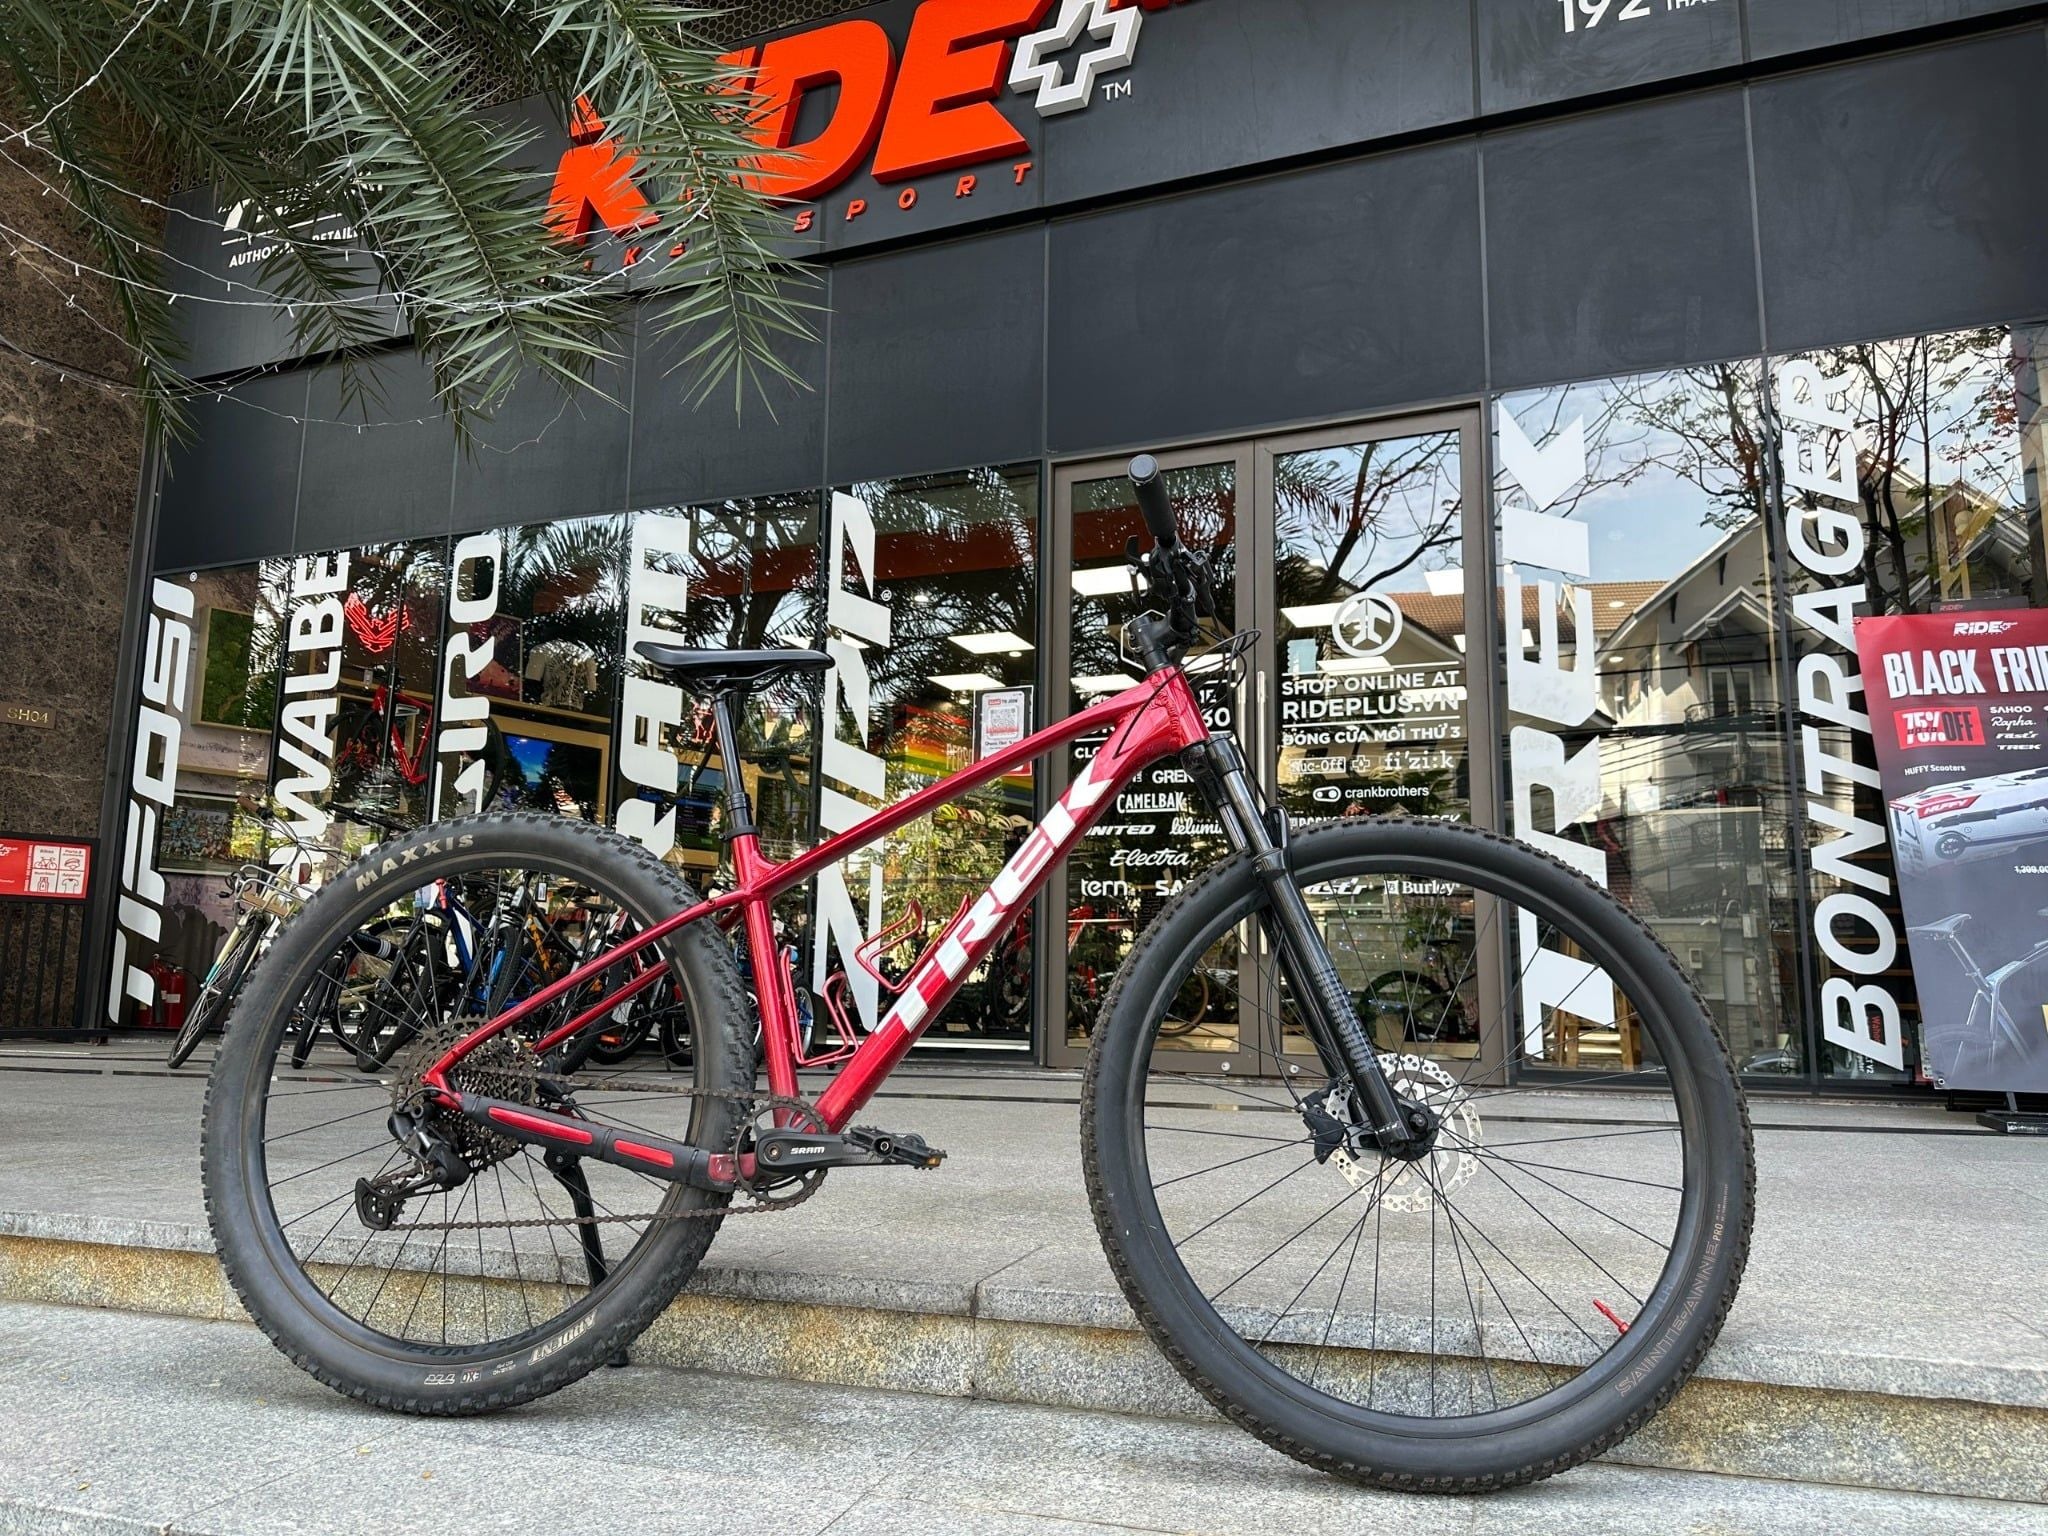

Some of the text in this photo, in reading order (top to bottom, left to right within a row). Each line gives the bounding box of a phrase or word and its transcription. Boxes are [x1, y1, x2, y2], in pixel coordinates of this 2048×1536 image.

[793, 162, 1033, 233] SPORT
[1281, 671, 1460, 695] SHOP ONLINE AT
[1882, 649, 1986, 699] BLACK
[616, 515, 690, 860] RAM
[1282, 693, 1459, 720] RIDEPLUS.VN
[1779, 358, 1904, 1071] BONTRAGER
[1990, 706, 2032, 714] SAHOO
[1410, 723, 1449, 740] THỨ
[1450, 726, 1461, 739] 3
[1498, 401, 1616, 1060] TREK
[1942, 711, 1973, 742] OFF
[1904, 764, 1966, 776] HUFFY Scooters
[107, 578, 195, 1024] TIFOSI
[1117, 792, 1184, 814] CAMELBAK
[1345, 786, 1430, 798] crankbrothers
[1924, 799, 1967, 816] HUFFY
[1085, 824, 1156, 836] NITED
[356, 834, 474, 892] MAXXIS
[1109, 848, 1190, 867] Electra
[875, 751, 1115, 1035] TREK
[1081, 878, 1128, 896] tern
[1402, 880, 1456, 896] Burley
[790, 1146, 826, 1155] SRAM
[1712, 1223, 1724, 1242] PRO
